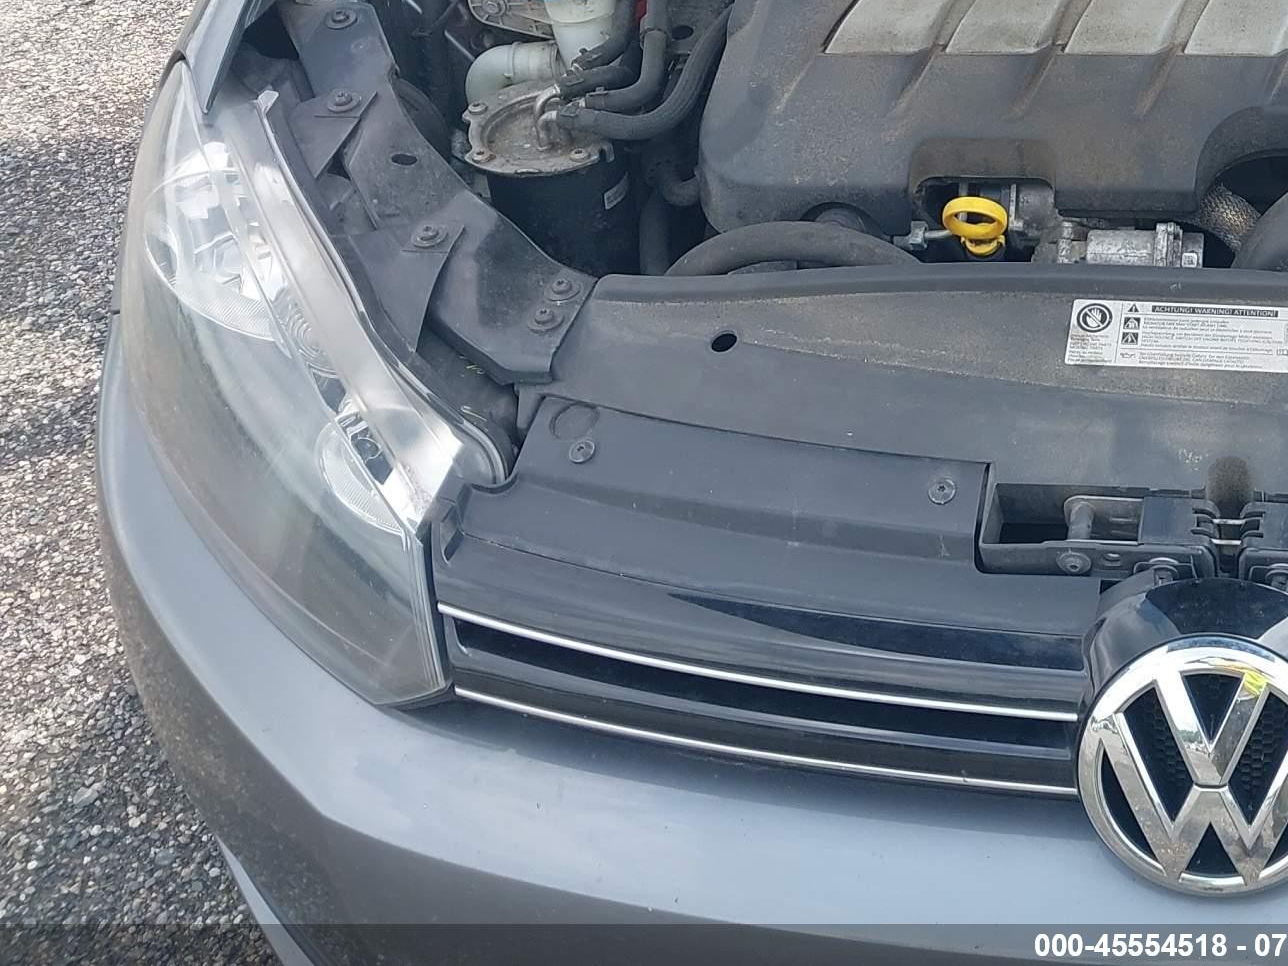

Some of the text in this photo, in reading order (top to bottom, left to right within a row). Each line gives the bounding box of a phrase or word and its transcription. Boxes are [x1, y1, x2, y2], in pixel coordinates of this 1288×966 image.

[1154, 305, 1277, 317] ACHTUNG! WARNING! ATTENTION!
